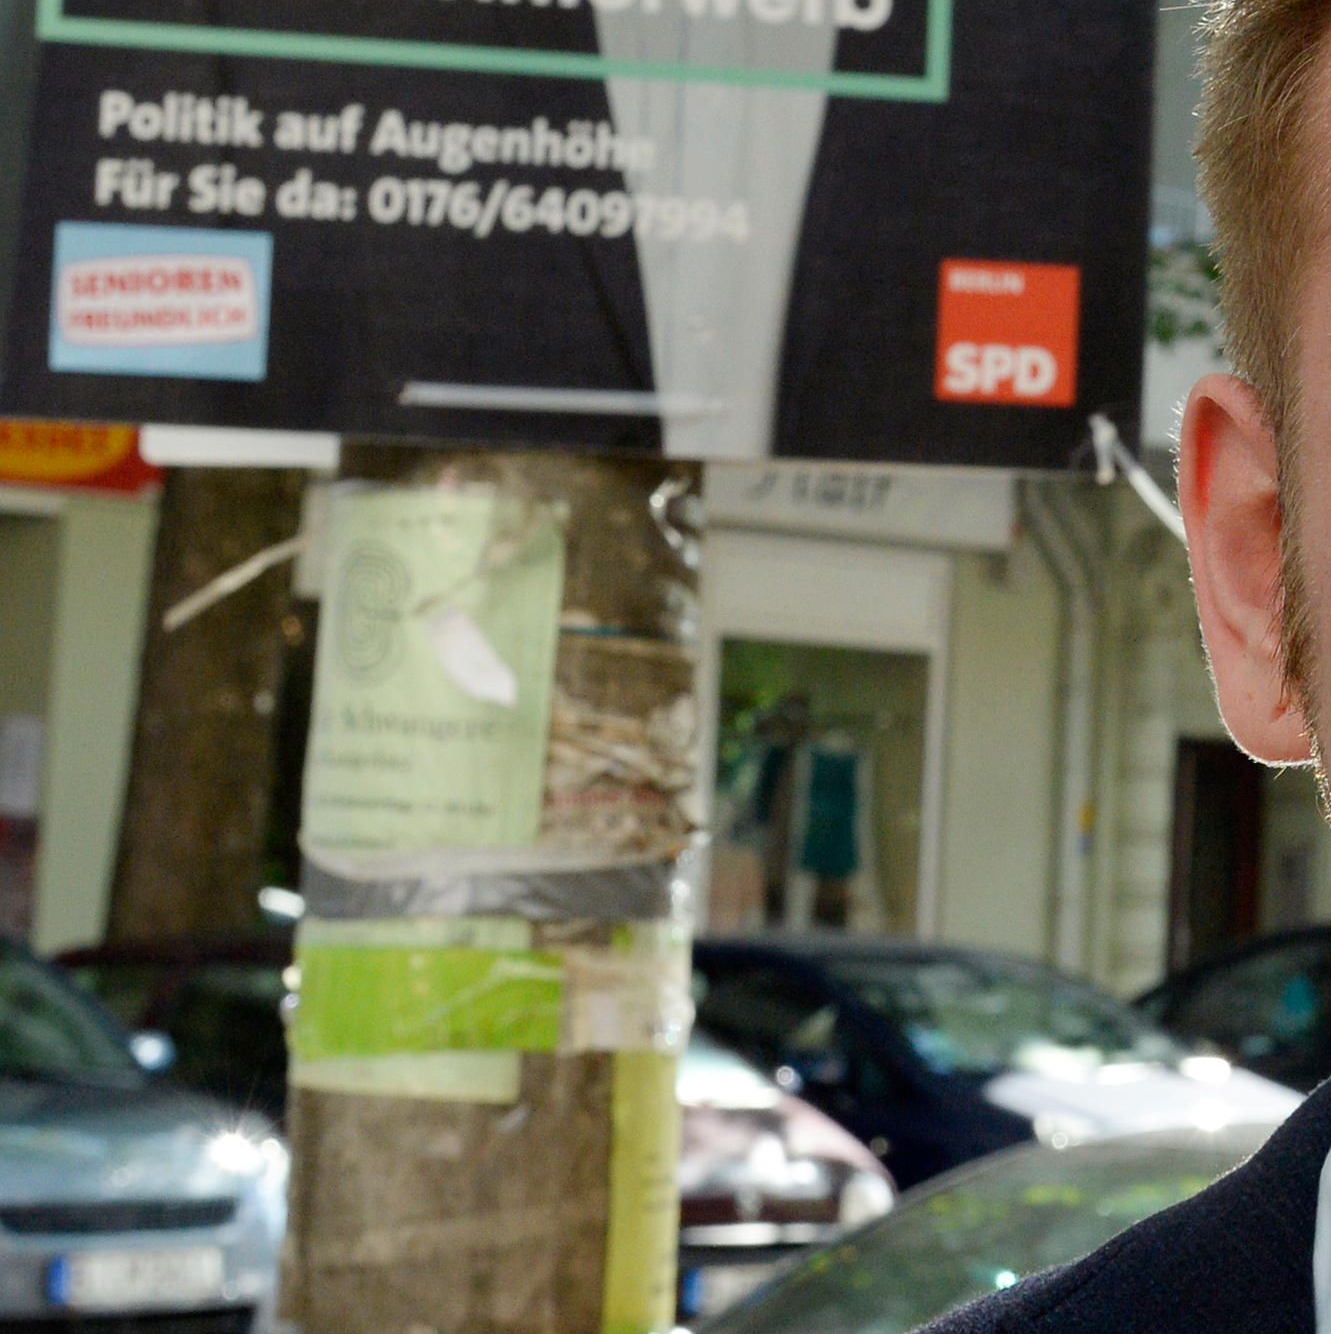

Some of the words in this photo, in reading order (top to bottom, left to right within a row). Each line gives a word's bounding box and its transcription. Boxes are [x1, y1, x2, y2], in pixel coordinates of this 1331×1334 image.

[99, 89, 264, 149] Politik
[273, 101, 366, 154] auf
[369, 106, 656, 174] Augenhöhe
[94, 157, 180, 211] Für
[187, 162, 266, 216] Sie
[275, 167, 357, 222] da:
[367, 175, 751, 245] 0176/64097994
[943, 340, 1058, 397] SPD
